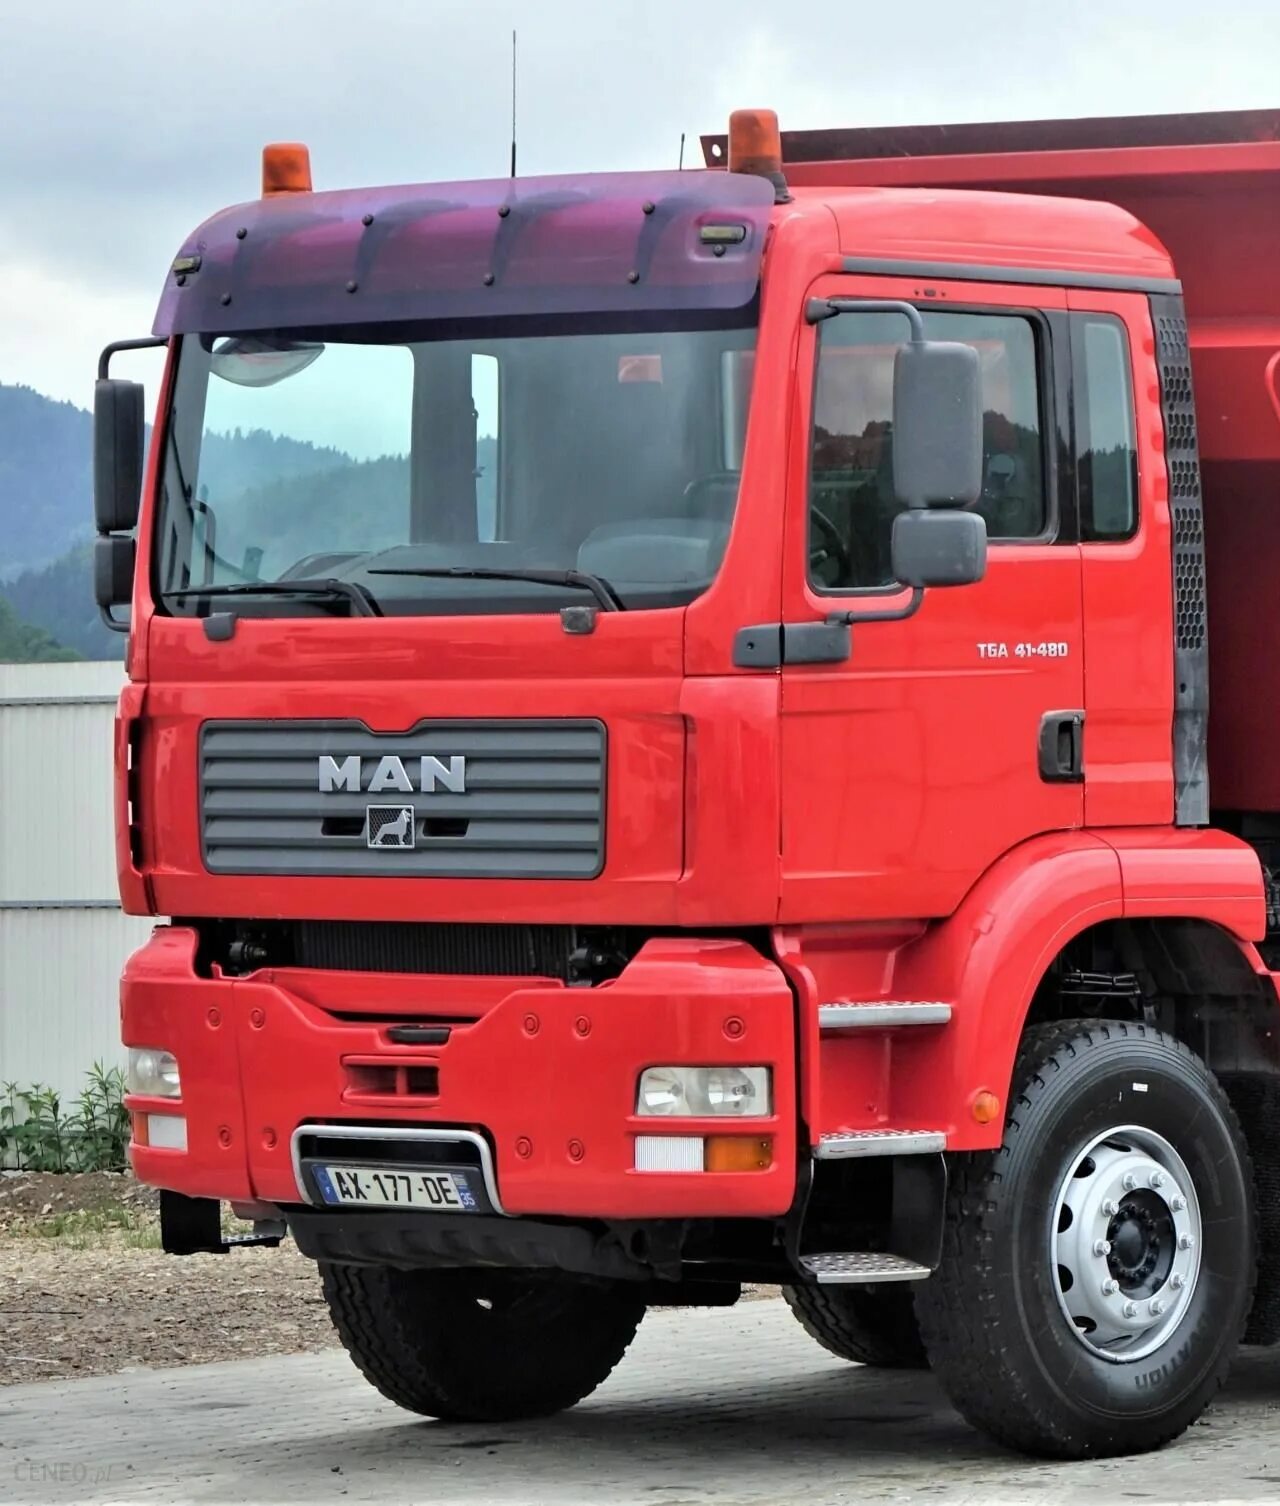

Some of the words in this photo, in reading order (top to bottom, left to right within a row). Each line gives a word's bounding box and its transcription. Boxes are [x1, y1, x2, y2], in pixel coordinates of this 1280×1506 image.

[977, 643, 1008, 658] TGA
[318, 755, 466, 793] MAN
[335, 1171, 459, 1204] AX-177-DE
[460, 1192, 476, 1206] 35
